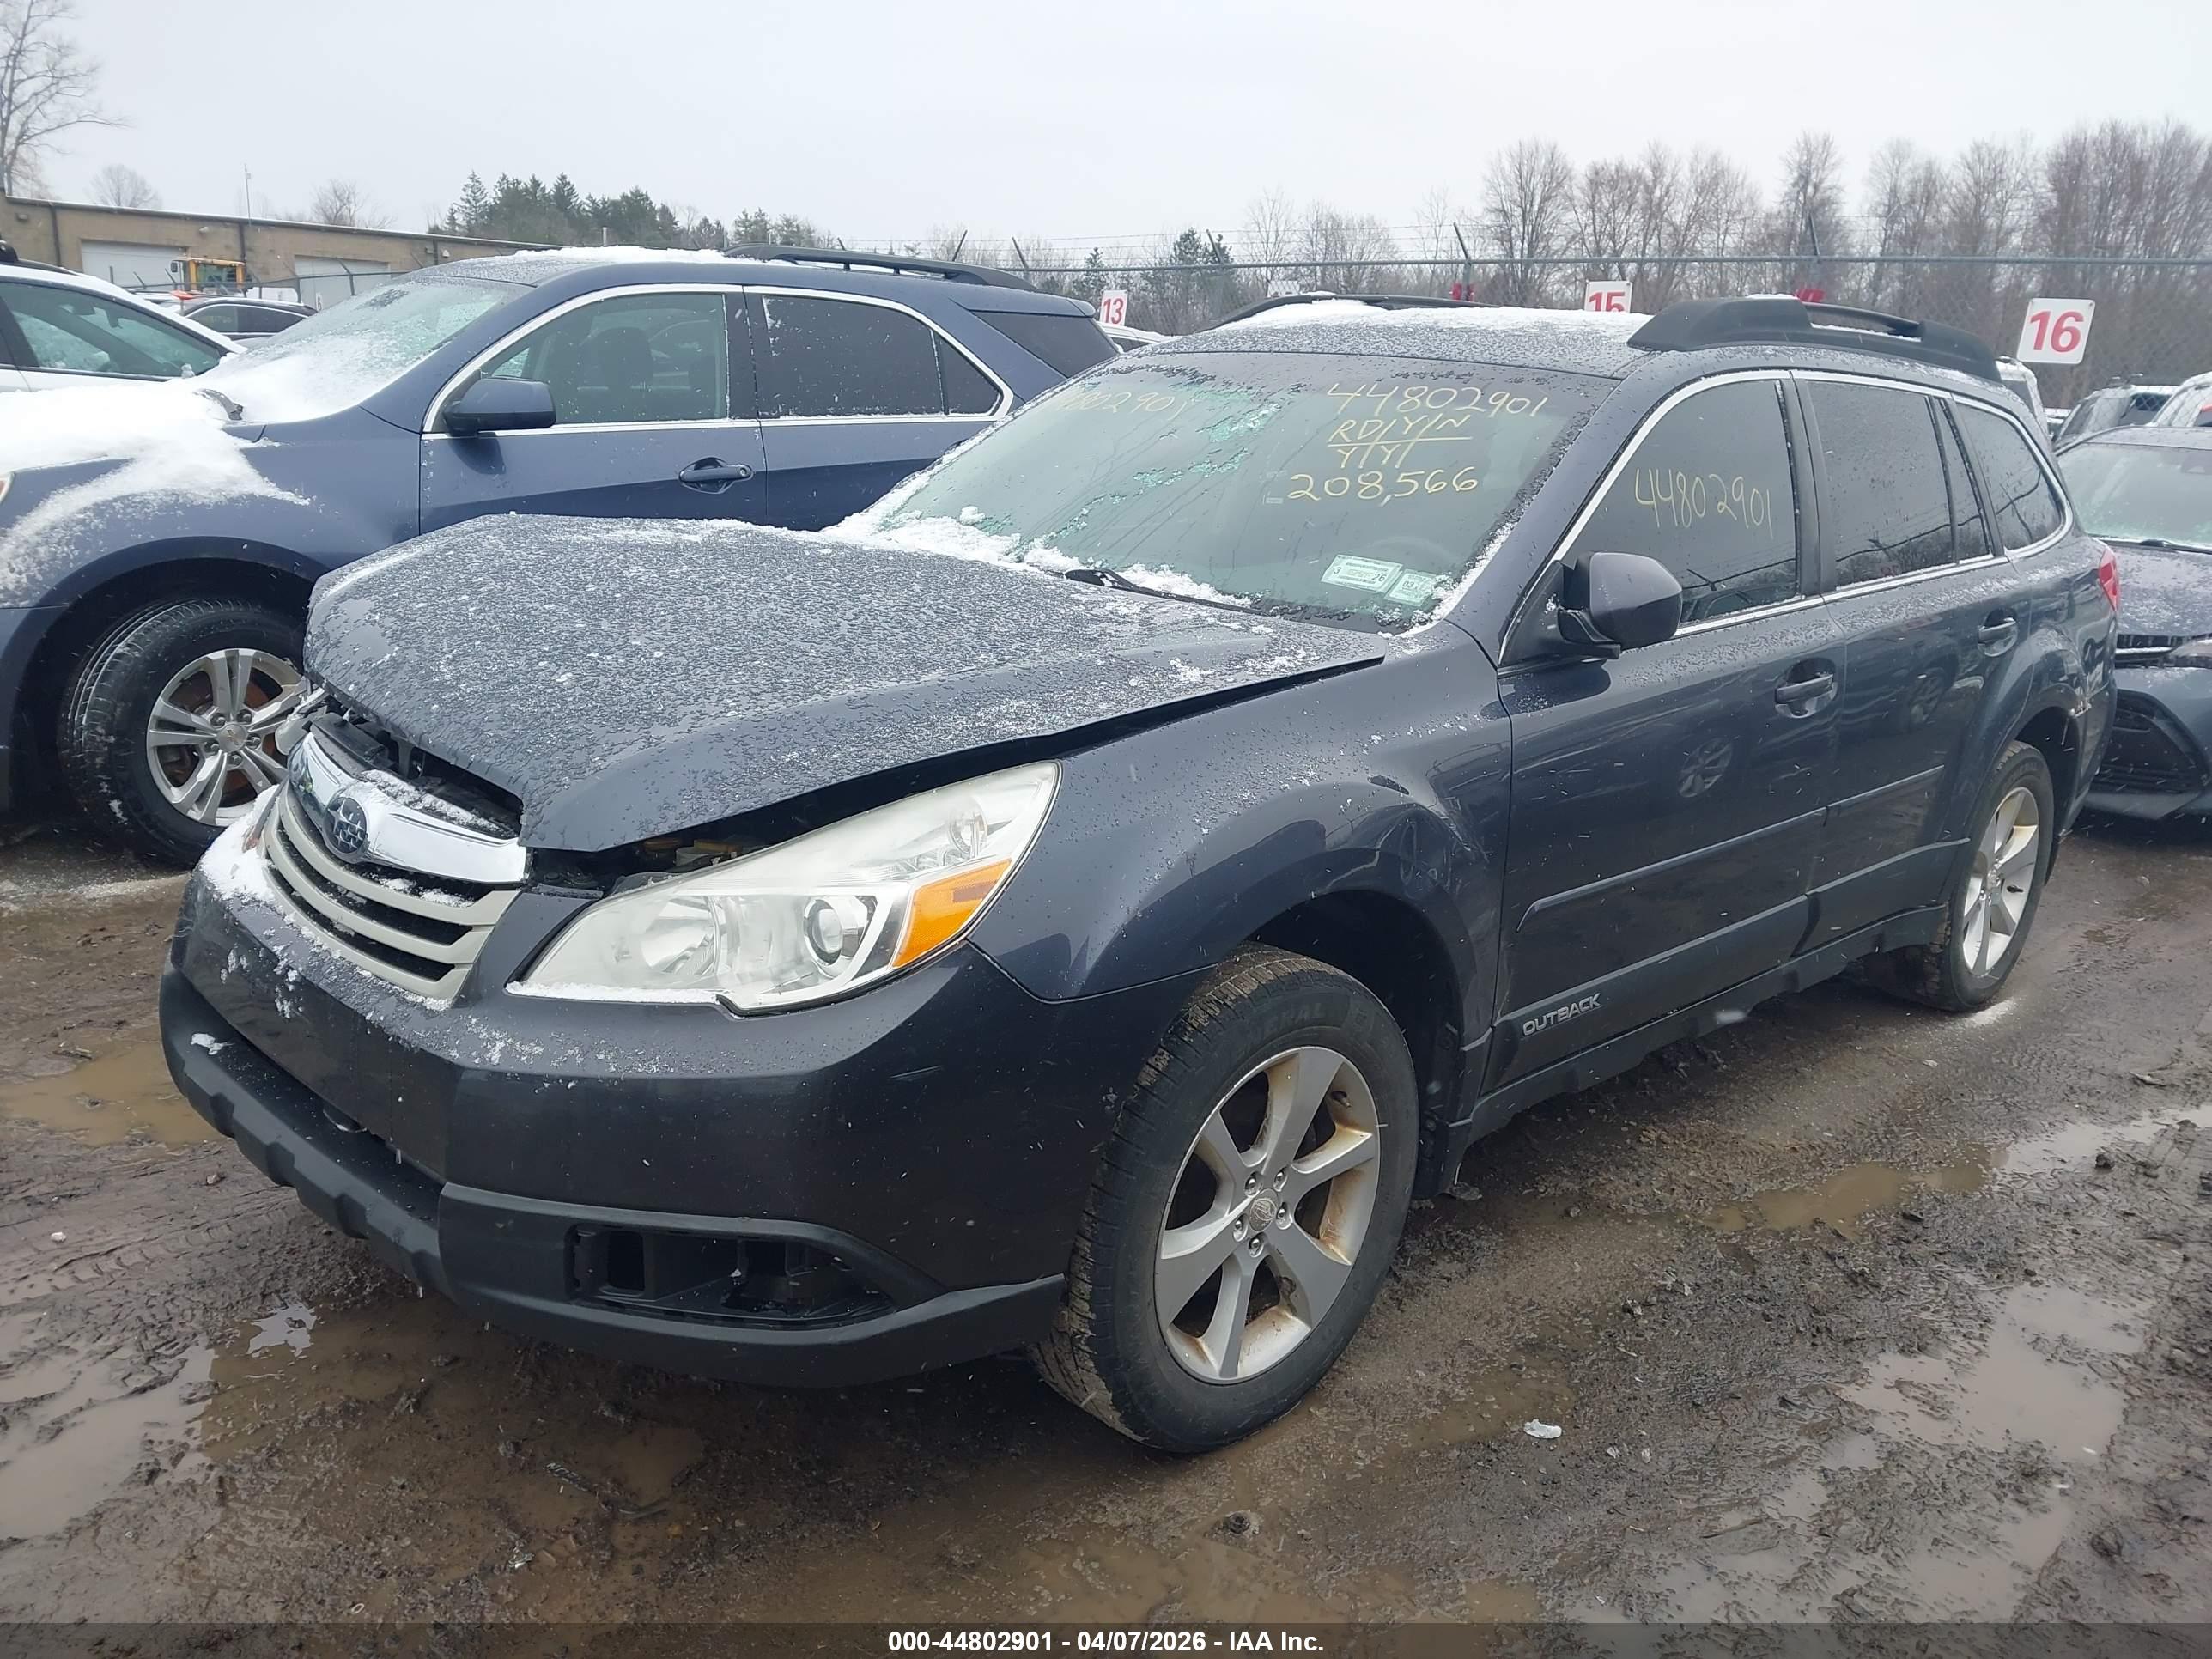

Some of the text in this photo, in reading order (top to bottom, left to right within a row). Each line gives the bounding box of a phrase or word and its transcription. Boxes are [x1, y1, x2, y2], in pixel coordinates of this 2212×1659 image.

[1103, 297, 1124, 325] 13
[1589, 291, 1626, 312] 15
[2029, 310, 2084, 353] 16
[1327, 383, 1548, 418] 44802901
[1287, 466, 1479, 507] 208,566
[1634, 468, 1775, 541] 44802901
[1333, 567, 1342, 575] 3
[1373, 573, 1387, 583] 26
[1522, 992, 1601, 1037] OUTBACK
